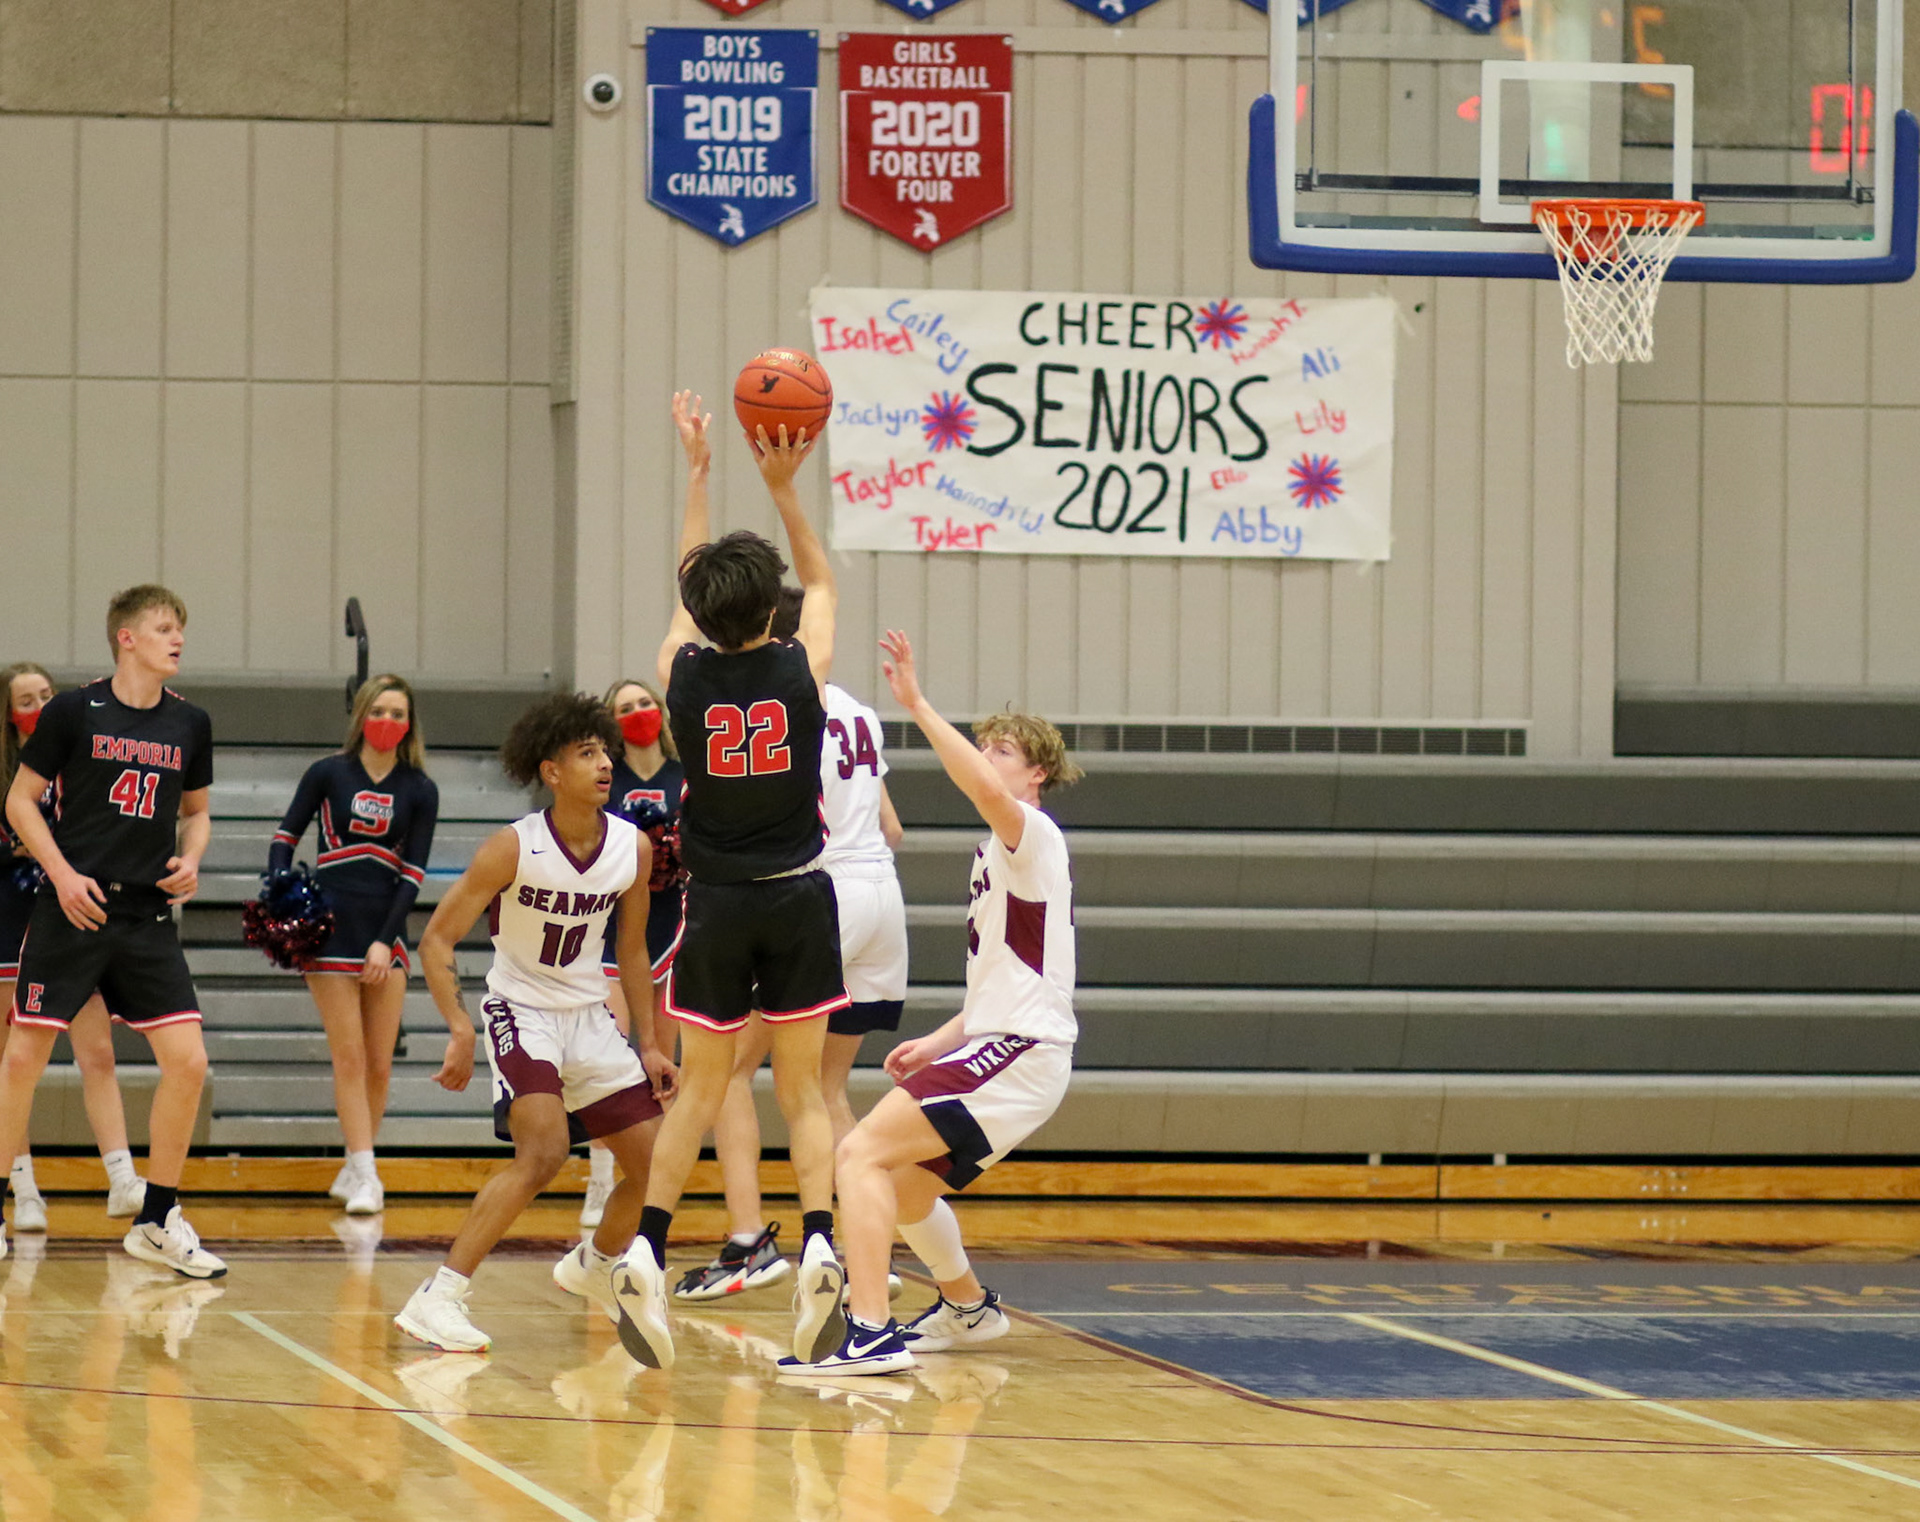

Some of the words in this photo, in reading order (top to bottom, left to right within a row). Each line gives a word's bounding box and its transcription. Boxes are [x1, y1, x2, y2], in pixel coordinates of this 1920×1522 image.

[704, 35, 762, 59] BOYS
[893, 41, 957, 64] GIRLS
[681, 60, 785, 84] BOWLING
[860, 65, 990, 90] BASKETBALL
[683, 95, 782, 142] 2019
[871, 100, 980, 147] 2020
[697, 146, 768, 172] STATE
[869, 150, 981, 177] FOREVER
[667, 173, 797, 198] CHAMPIONS
[897, 179, 954, 202] FOUR
[819, 317, 915, 355] Isabel
[886, 299, 969, 374] Cailey
[1020, 302, 1197, 353] CHEER
[1301, 347, 1341, 382] Ali
[835, 402, 920, 437] Jaclyn
[966, 363, 1270, 462] SENIORS
[1295, 399, 1347, 435] Lily
[832, 458, 935, 510] Taylor
[1054, 461, 1190, 543] 2021
[910, 516, 997, 551] Tyler
[1211, 506, 1302, 555] Abby
[92, 734, 182, 771] EMPORIA
[704, 699, 791, 777] 22
[825, 716, 878, 780] 34
[109, 769, 161, 819] 41
[349, 789, 395, 837] S
[539, 921, 589, 968] 10
[26, 983, 44, 1012] E
